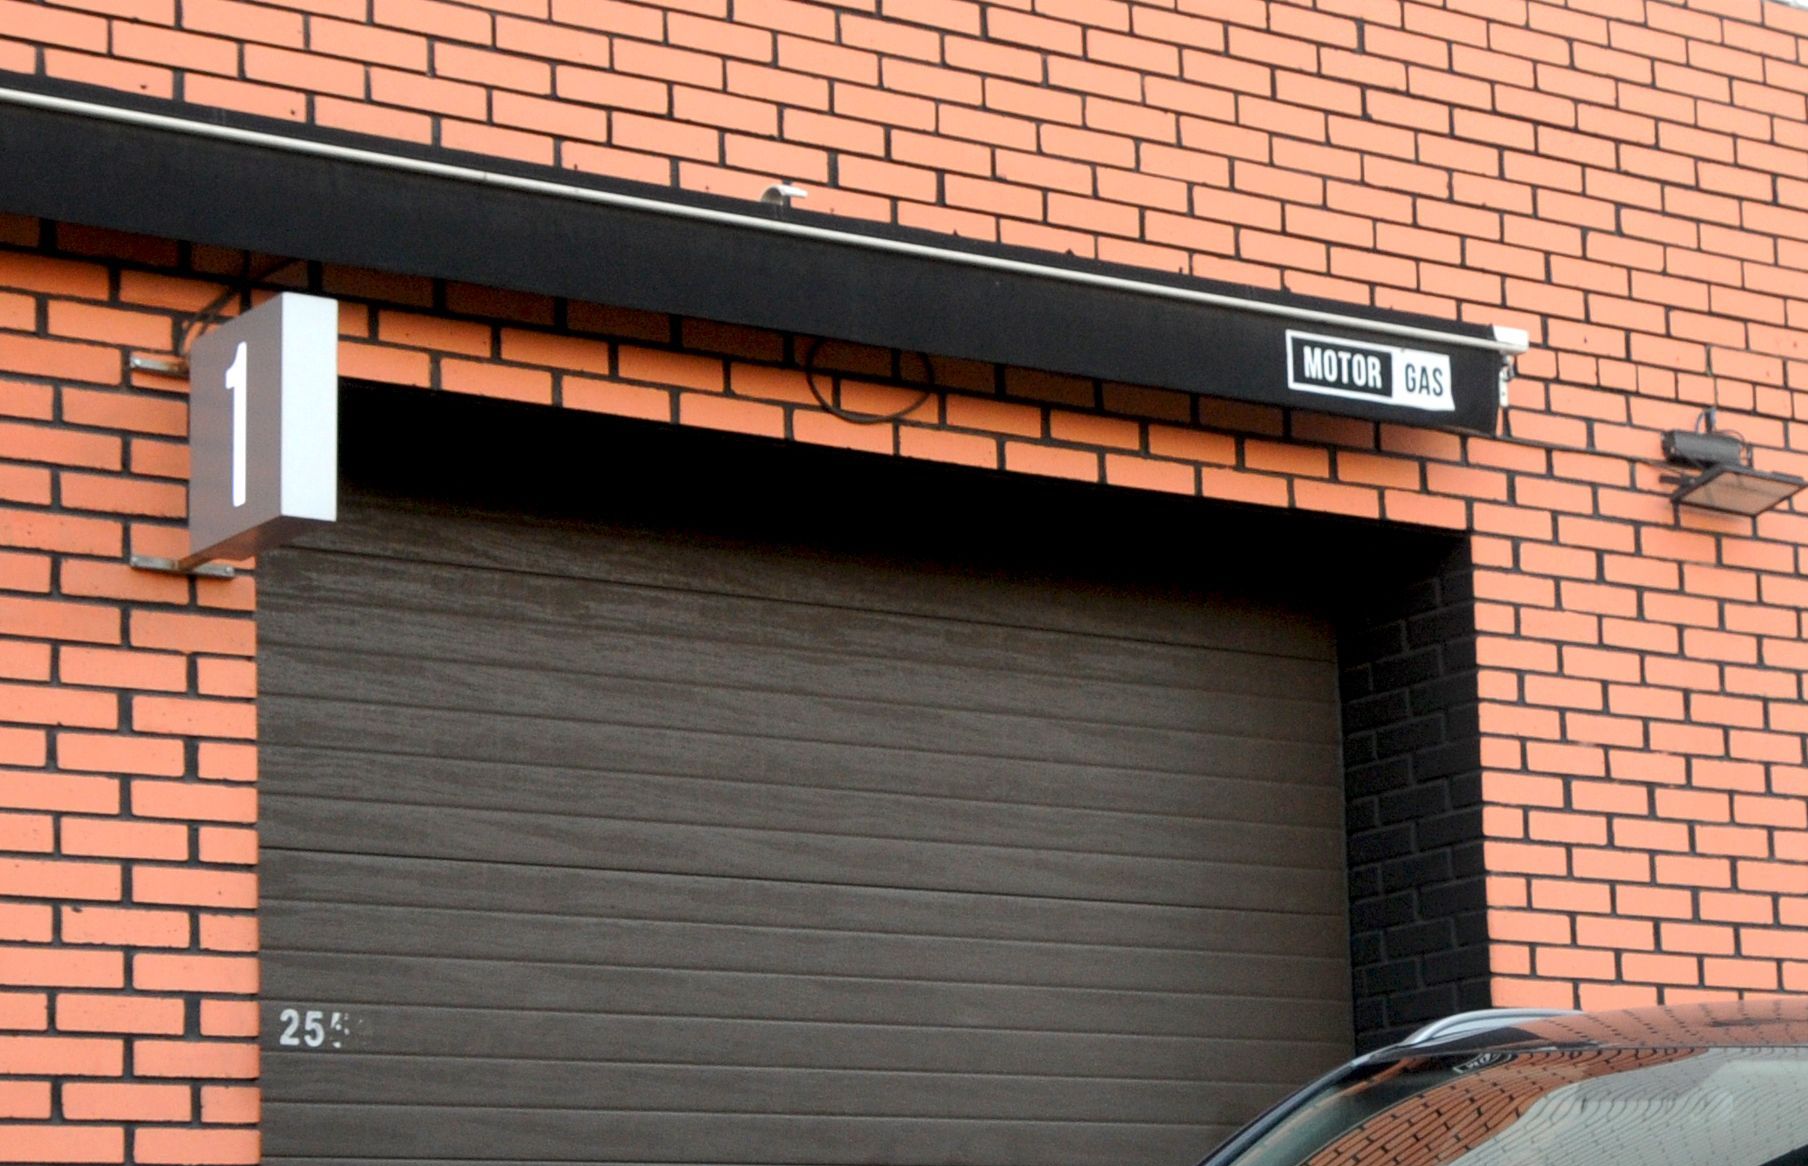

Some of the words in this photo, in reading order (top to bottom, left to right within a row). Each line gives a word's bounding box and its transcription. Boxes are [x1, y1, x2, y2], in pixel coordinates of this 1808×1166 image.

[224, 341, 248, 507] 1
[1303, 346, 1382, 389] MOTOR
[1405, 363, 1444, 397] GAS
